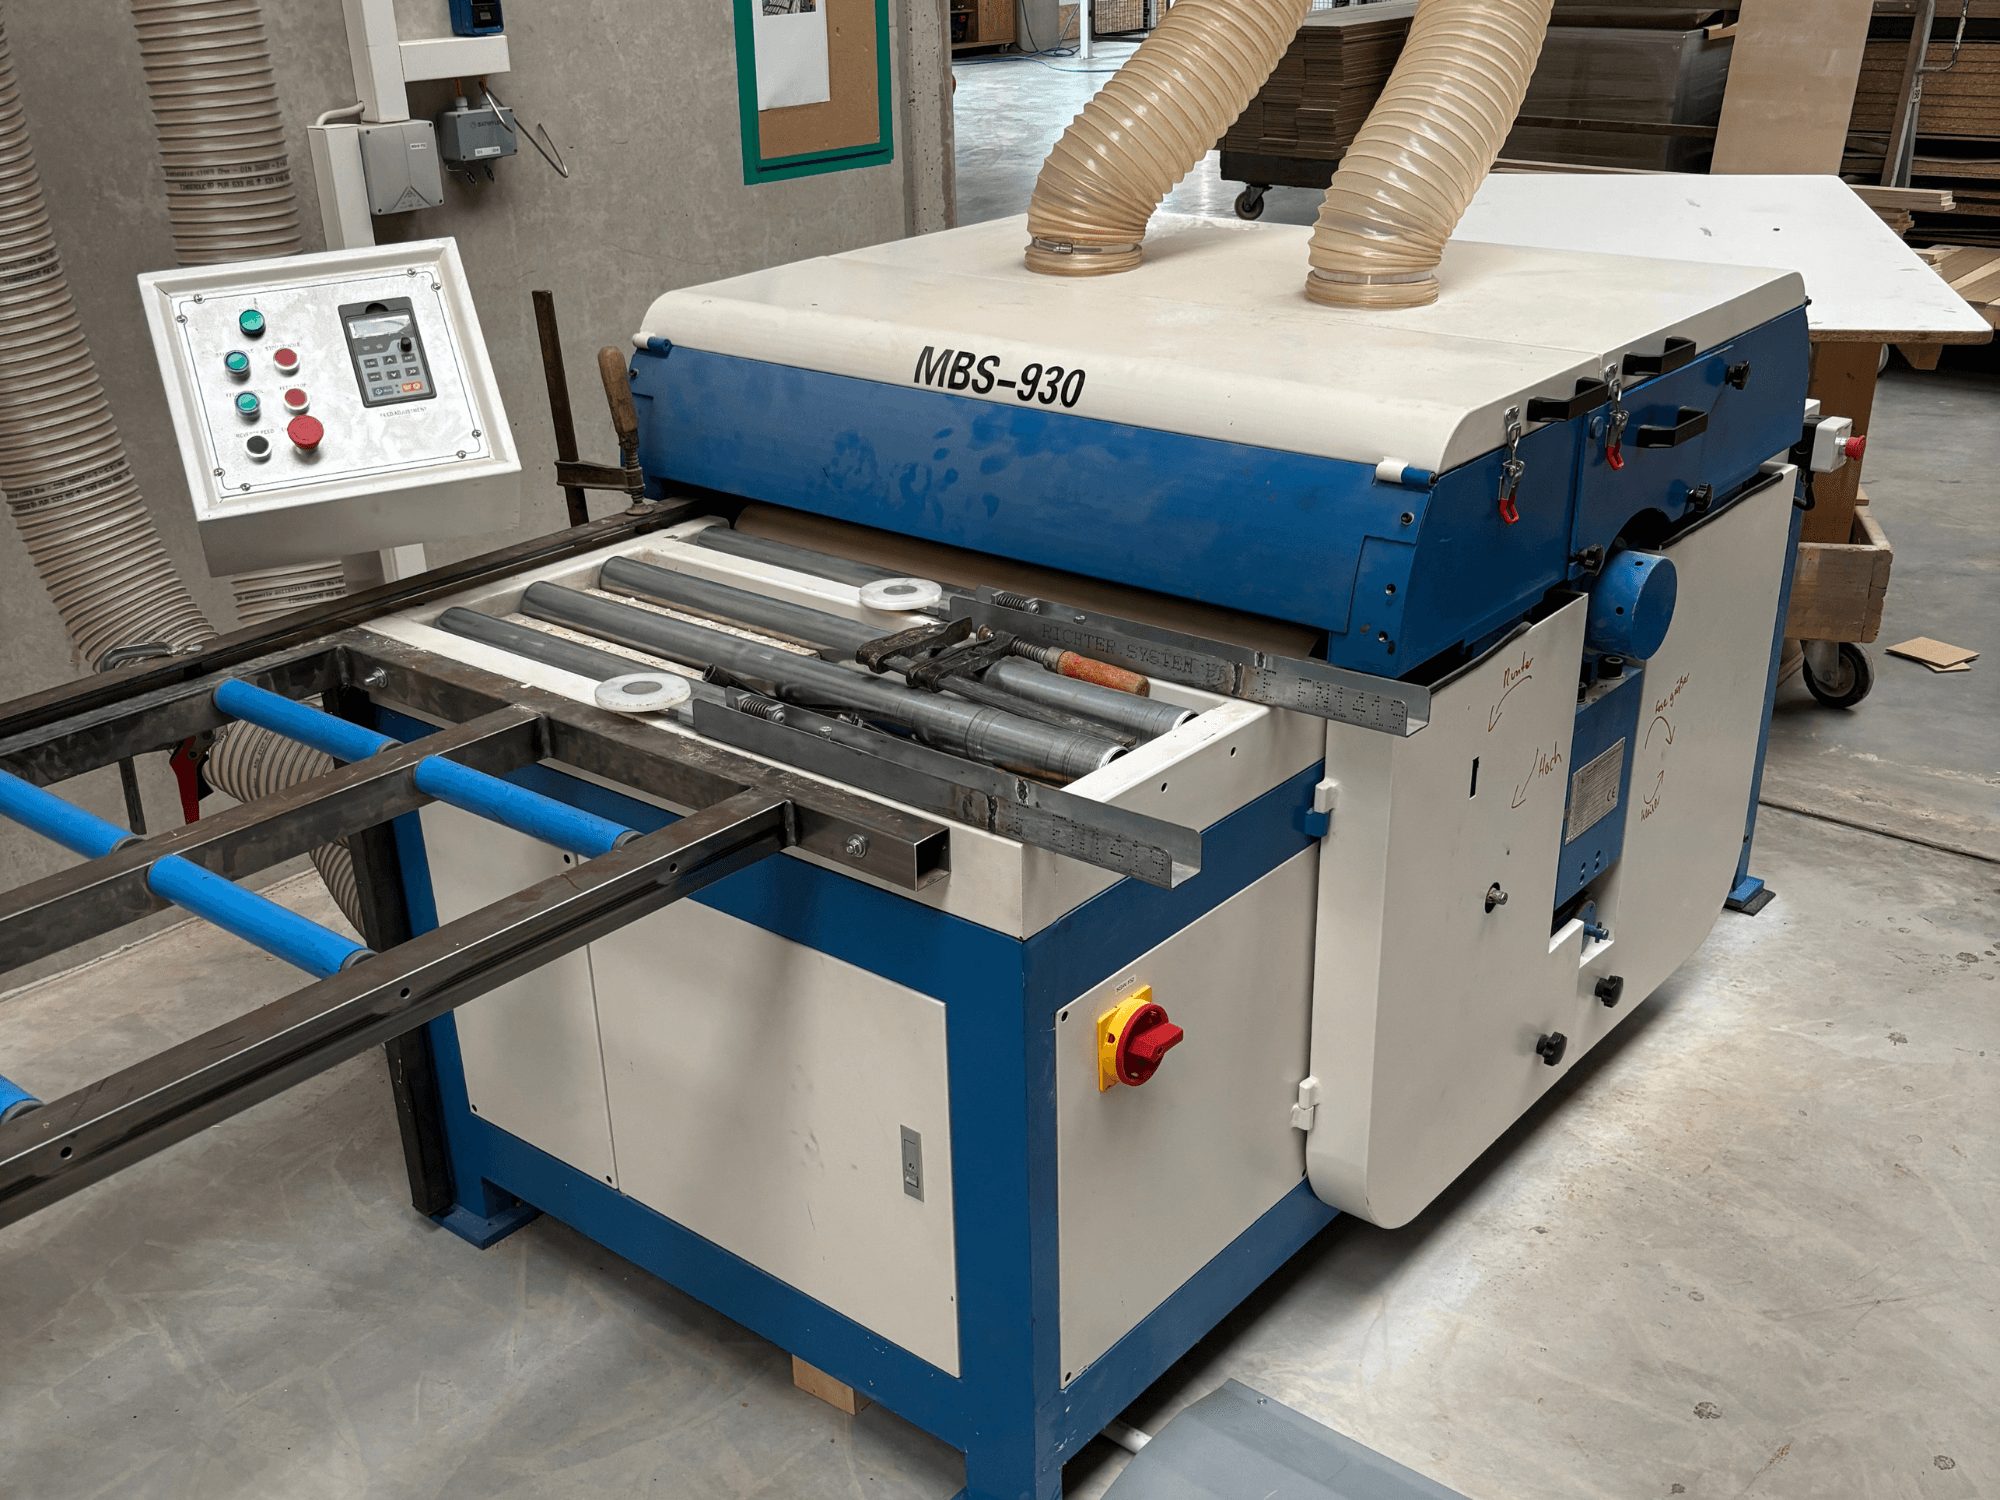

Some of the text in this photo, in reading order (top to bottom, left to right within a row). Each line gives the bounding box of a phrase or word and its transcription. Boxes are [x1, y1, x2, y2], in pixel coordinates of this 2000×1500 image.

[914, 345, 1086, 408] MBS-930
[1042, 624, 1116, 655] RICHTER
[1126, 643, 1196, 675] SYSTEM
[1538, 740, 1562, 779] Hoch
